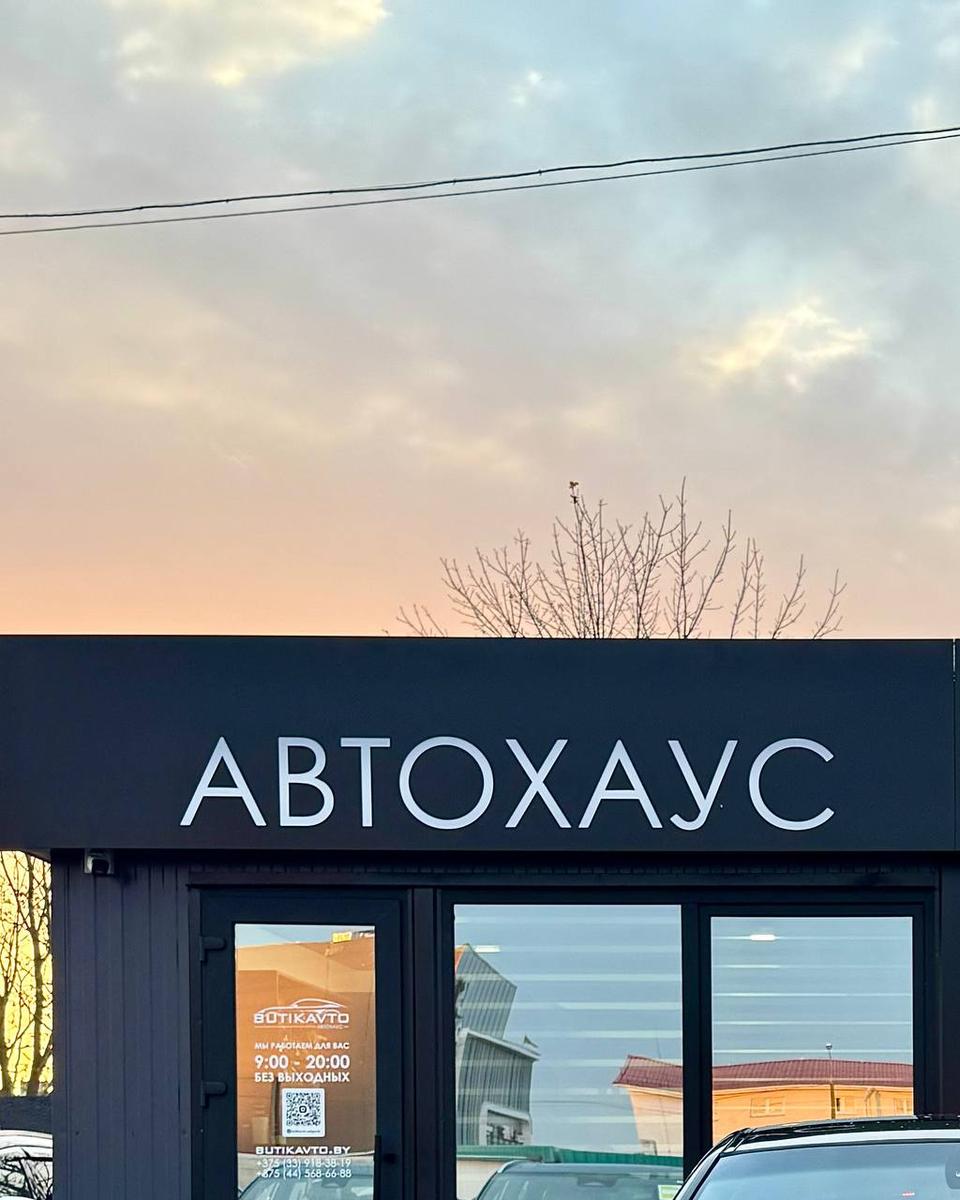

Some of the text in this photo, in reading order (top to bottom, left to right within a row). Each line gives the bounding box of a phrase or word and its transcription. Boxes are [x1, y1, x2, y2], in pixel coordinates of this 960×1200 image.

[180, 736, 836, 831] АВТОХАУС
[253, 1012, 350, 1024] BUTIKAVTO
[270, 1042, 313, 1050] РАБОТАЕМ
[314, 1042, 331, 1050] ДЛЯ
[255, 1054, 289, 1069] 9:00
[305, 1054, 350, 1069] 20:00
[255, 1072, 351, 1084] БЕЗ ВЫХОДНЫХ
[255, 1146, 352, 1155] BUTIKAVTO.BY
[283, 1158, 301, 1169] (33)
[283, 1168, 301, 1179] (44)
[304, 1168, 352, 1178] 568-66-88
